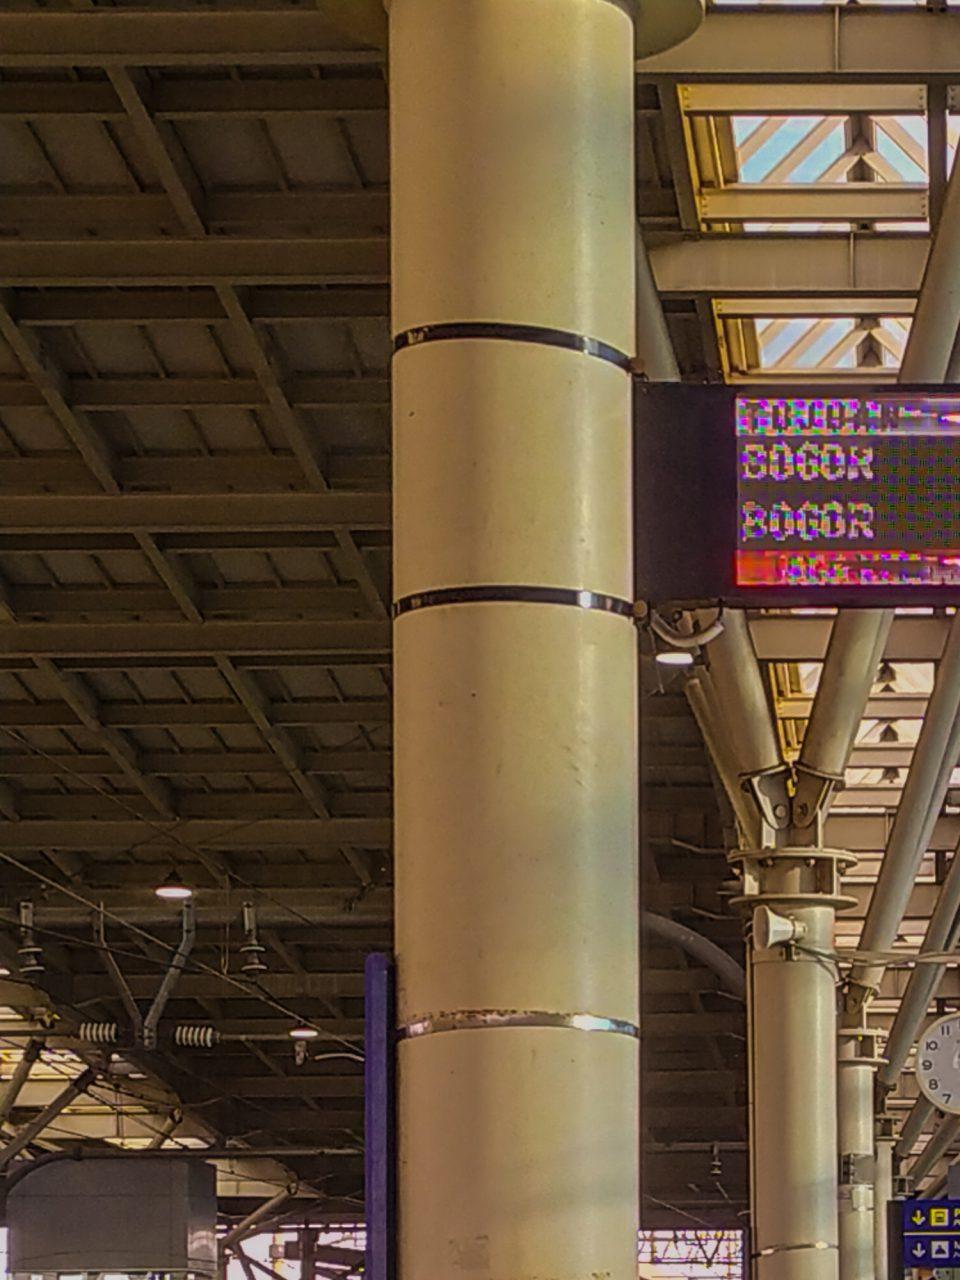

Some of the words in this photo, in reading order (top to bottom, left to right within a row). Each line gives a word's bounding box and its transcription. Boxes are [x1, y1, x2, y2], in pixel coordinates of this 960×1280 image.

[740, 442, 875, 481] BOGOR
[740, 501, 875, 541] BOGOR
[941, 1025, 950, 1036] 11
[925, 1040, 938, 1051] 10
[921, 1060, 932, 1071] 9
[928, 1079, 938, 1090] 8
[942, 1093, 951, 1104] 7
